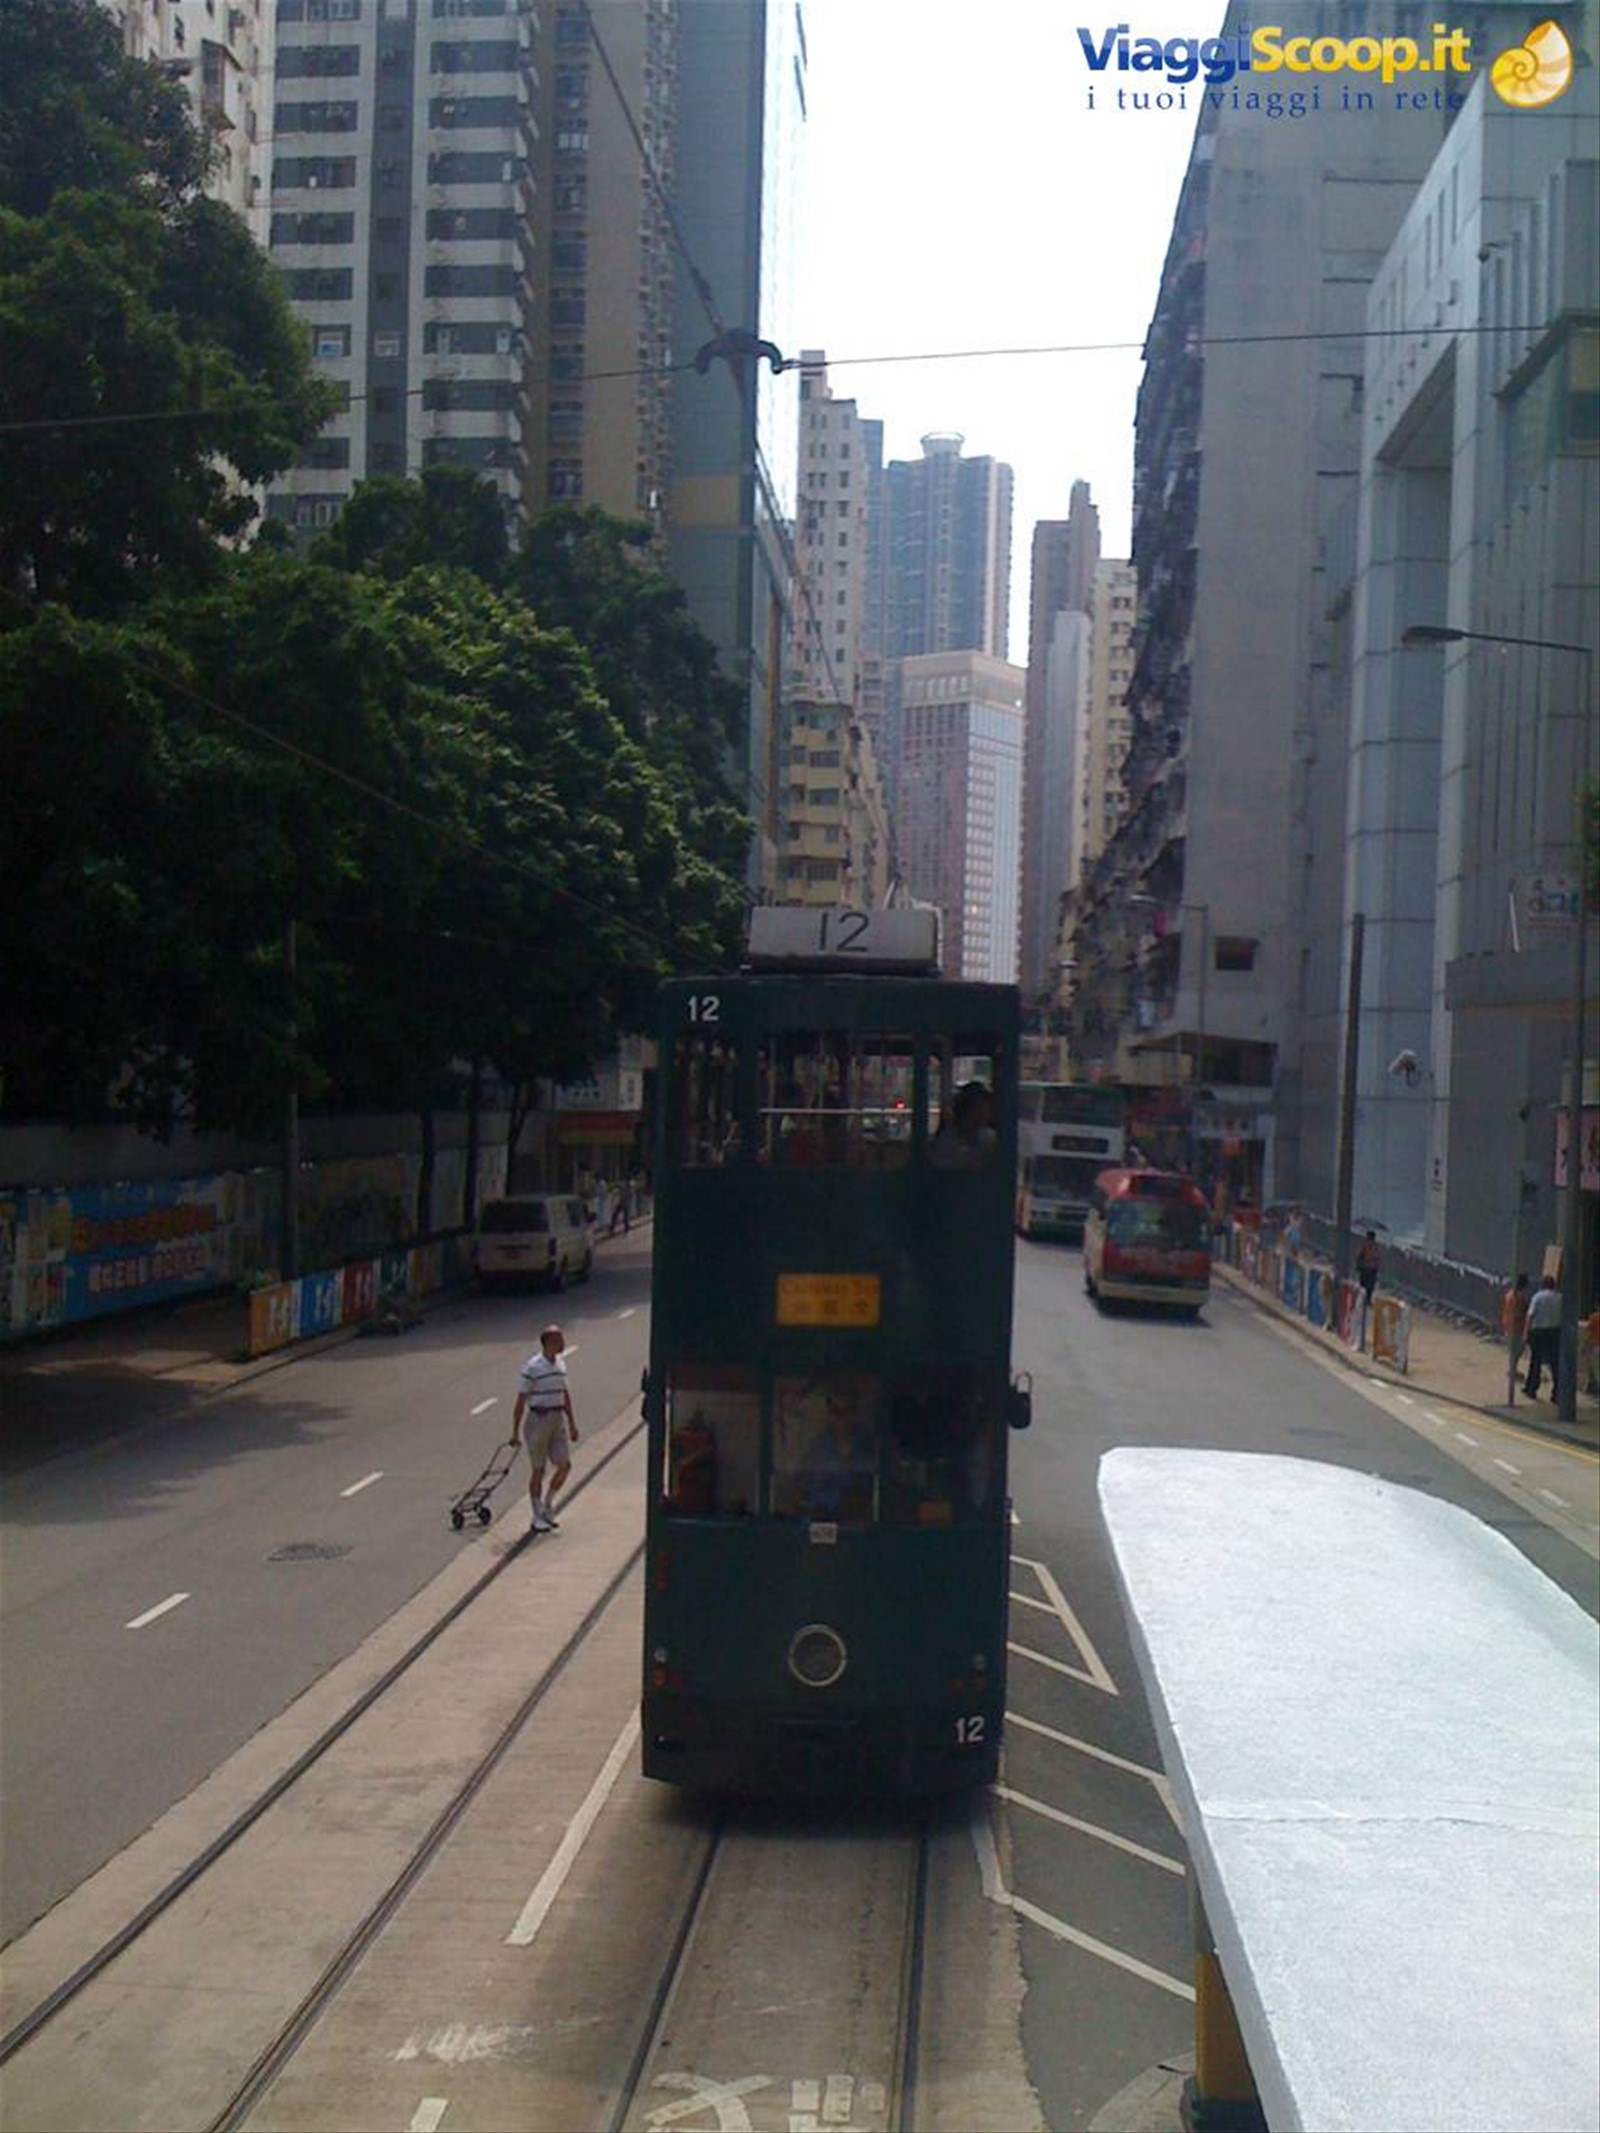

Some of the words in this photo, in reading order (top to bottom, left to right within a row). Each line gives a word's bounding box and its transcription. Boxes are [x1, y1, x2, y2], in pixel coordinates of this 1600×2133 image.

[818, 910, 869, 953] 12
[688, 992, 720, 1022] 12
[954, 1716, 985, 1743] 12
